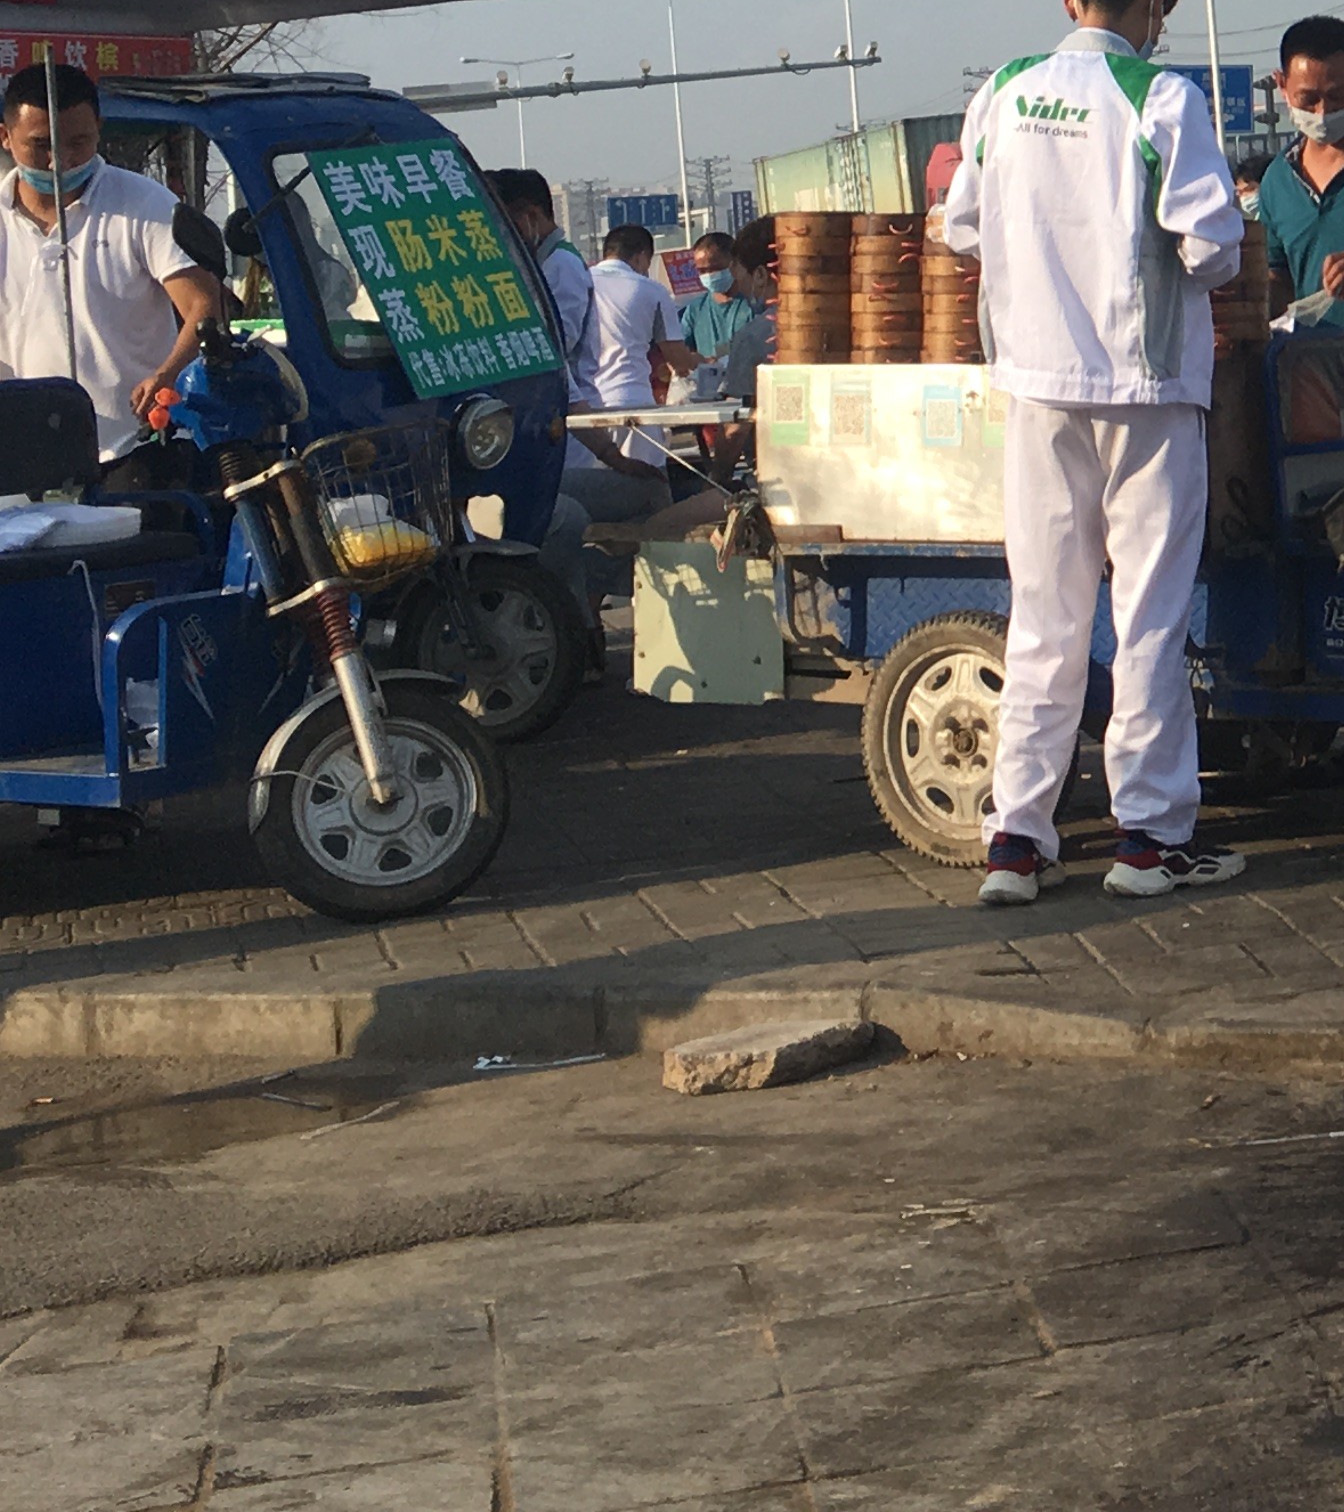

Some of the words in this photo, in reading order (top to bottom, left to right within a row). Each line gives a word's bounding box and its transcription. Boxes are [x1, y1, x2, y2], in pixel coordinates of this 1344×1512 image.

[1034, 123, 1051, 136] for
[1052, 125, 1089, 140] dreams
[322, 148, 476, 216] 美味早餐
